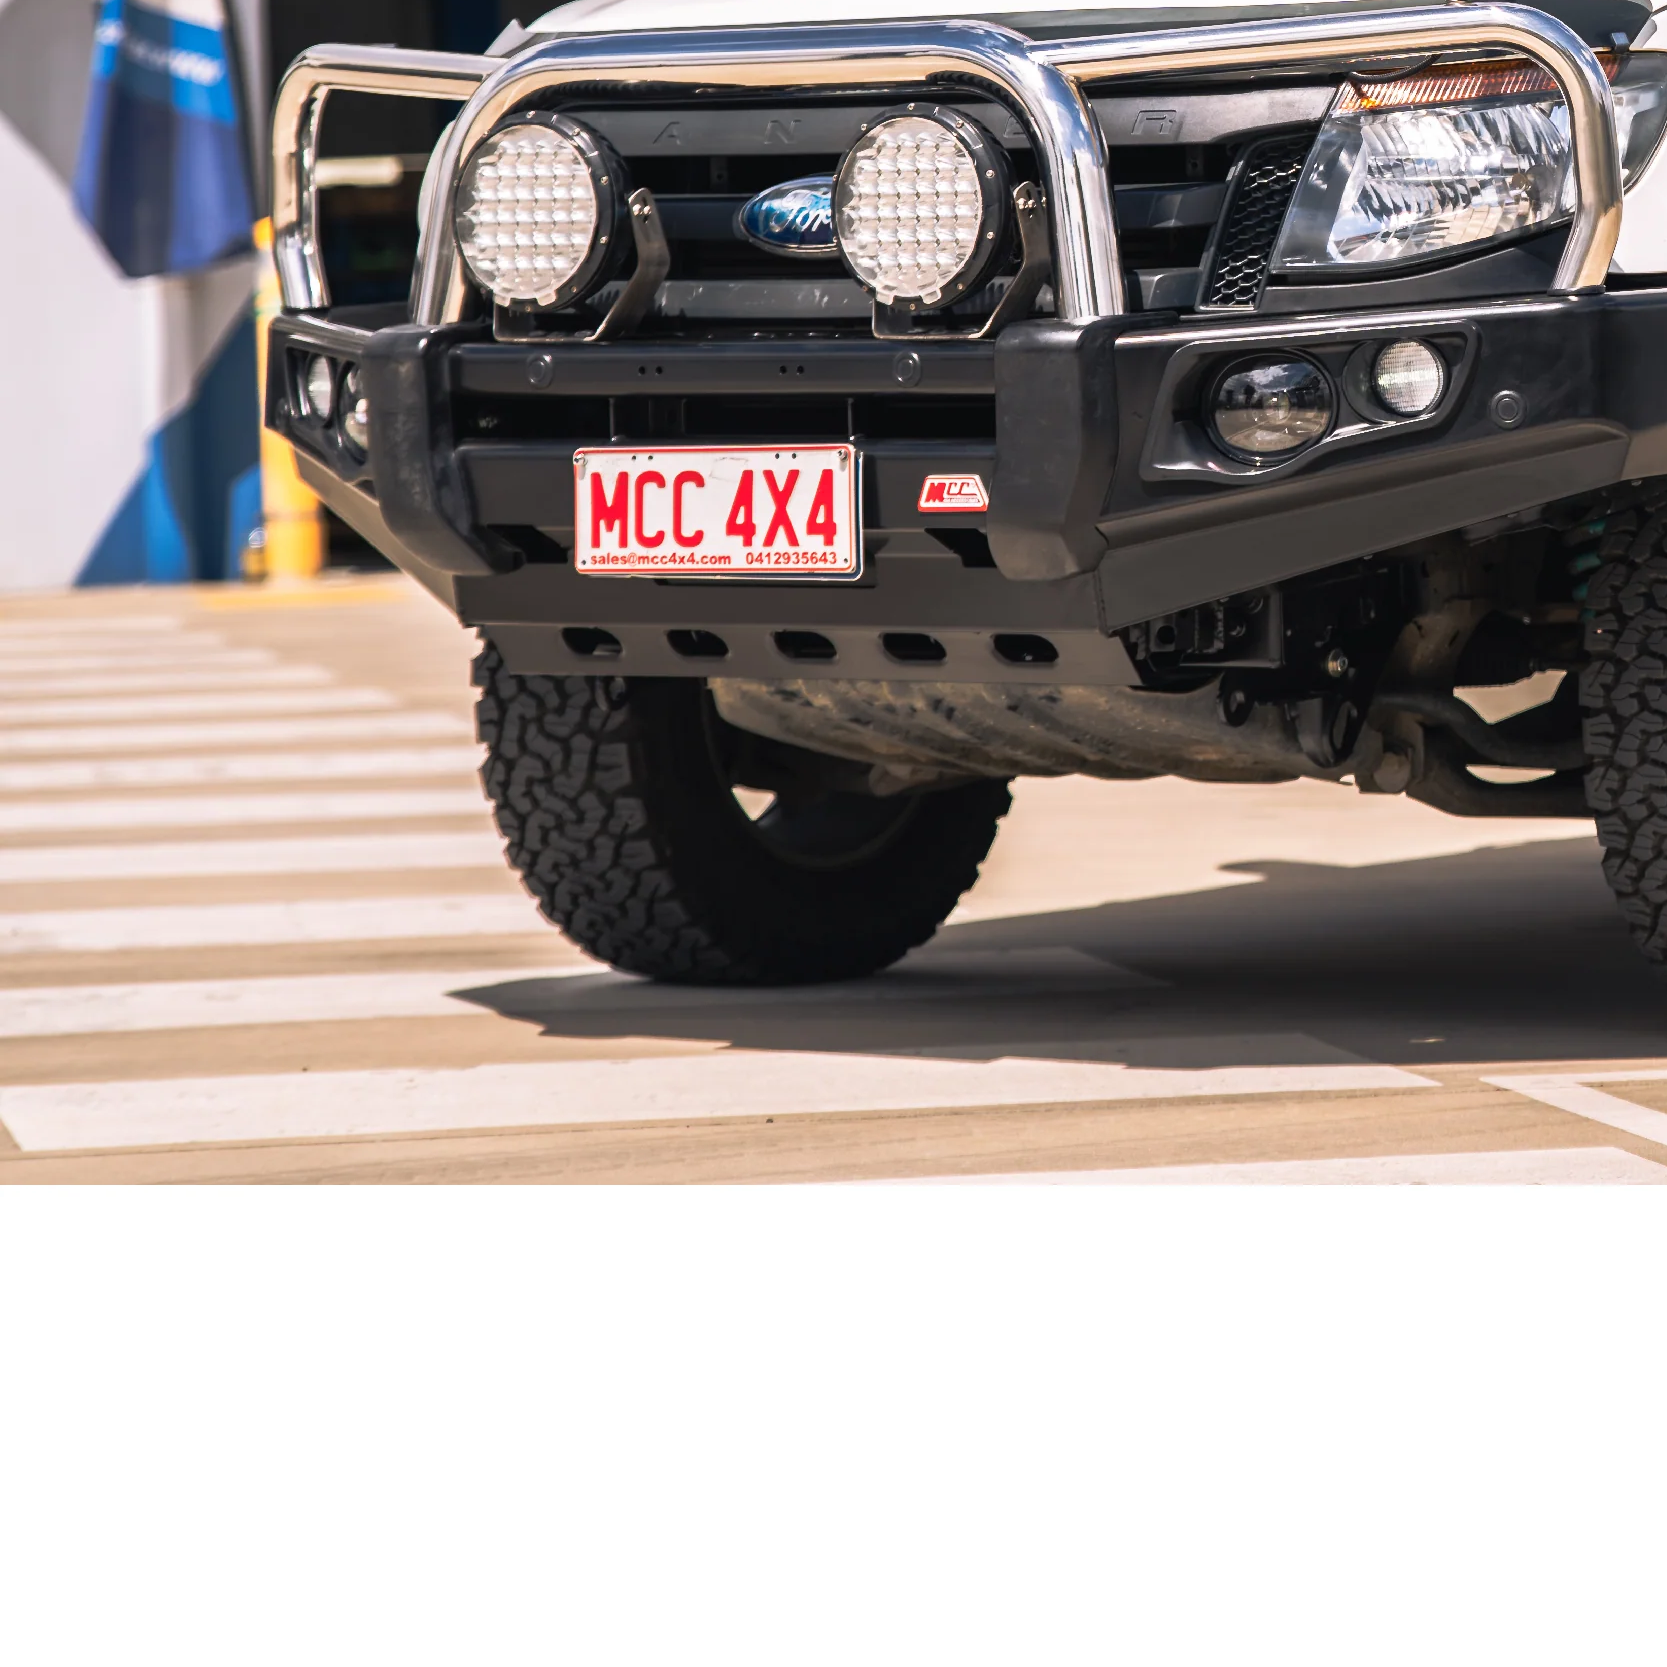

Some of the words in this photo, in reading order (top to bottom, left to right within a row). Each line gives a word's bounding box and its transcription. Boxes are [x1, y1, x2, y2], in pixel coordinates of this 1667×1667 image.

[761, 189, 832, 232] For
[924, 482, 978, 502] MCC
[590, 469, 705, 549] MCC
[726, 469, 837, 548] 4X4
[590, 552, 732, 566] sales@mcc4x4.com
[745, 552, 837, 565] 0412935643
